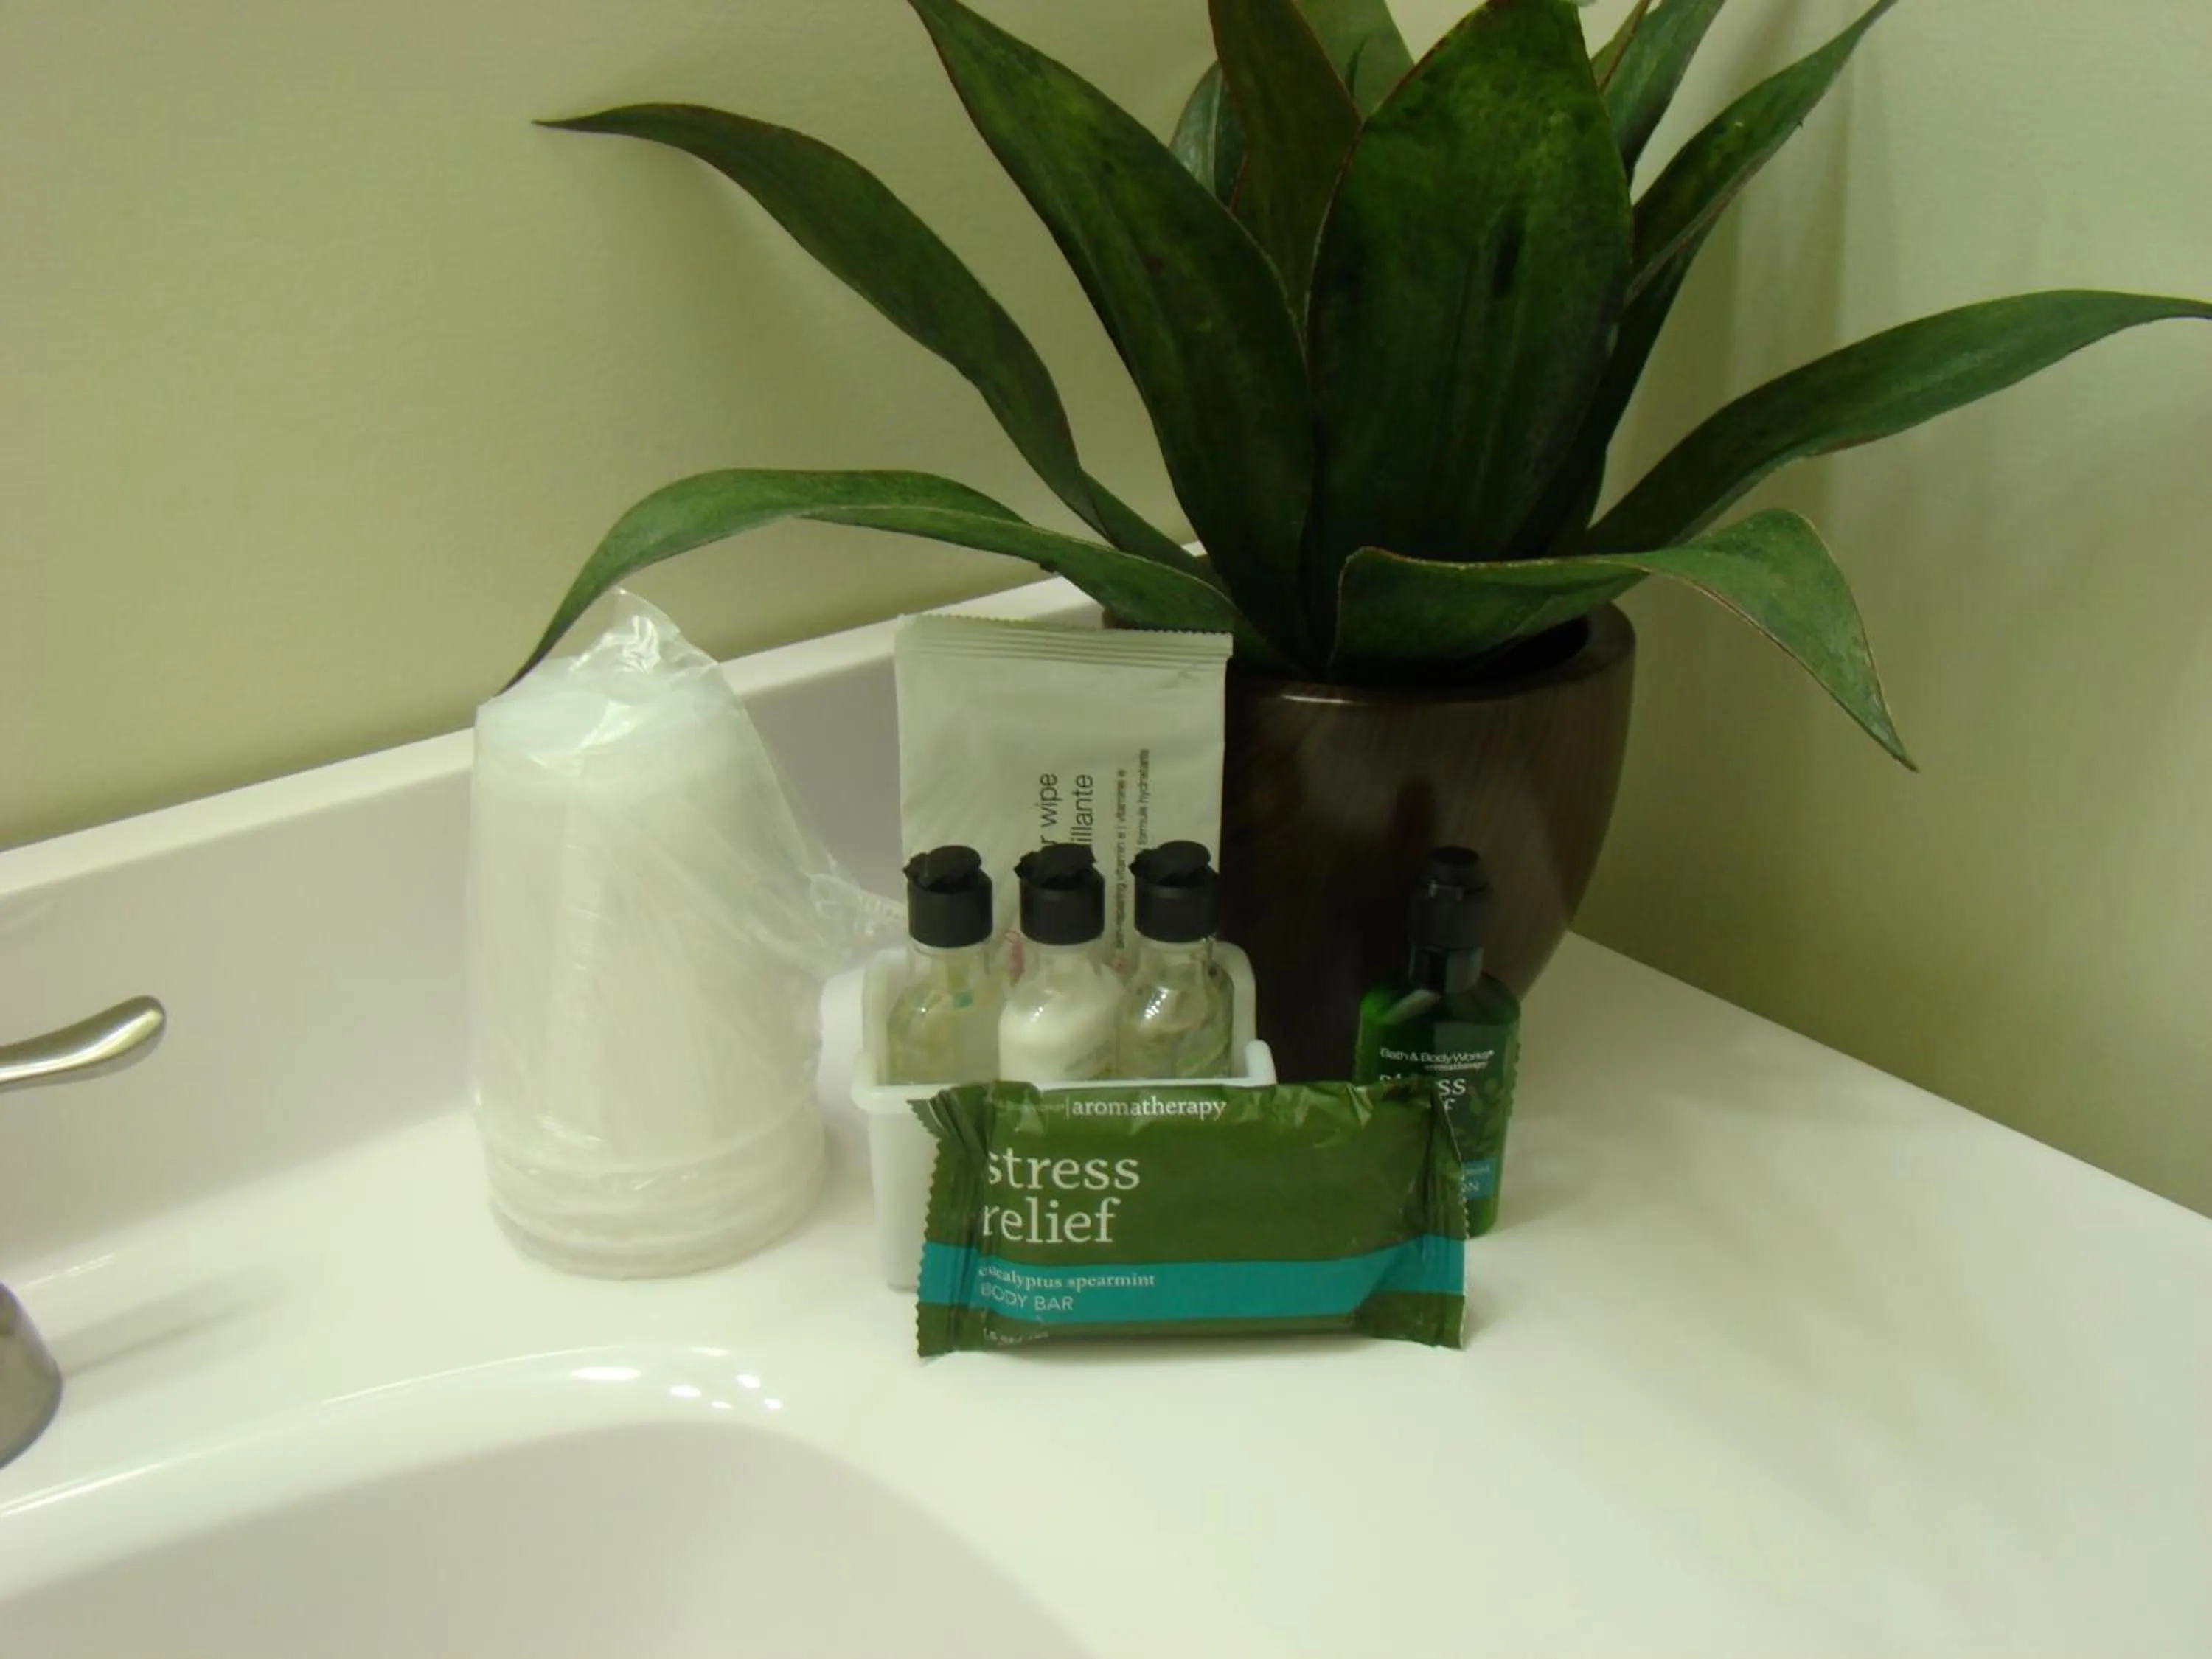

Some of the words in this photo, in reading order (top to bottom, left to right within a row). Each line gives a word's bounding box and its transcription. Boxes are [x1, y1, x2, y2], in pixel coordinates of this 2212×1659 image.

[1034, 773, 1063, 827] wipe
[1071, 774, 1093, 843] illante
[1071, 1095, 1228, 1121] aromatherapy
[988, 1147, 1141, 1191] stress
[982, 1197, 1121, 1244] relief
[978, 1265, 1063, 1292] eucalyptus
[1067, 1272, 1156, 1293] spearmint
[980, 1282, 1029, 1309] BODY
[1034, 1295, 1074, 1311] BAR
